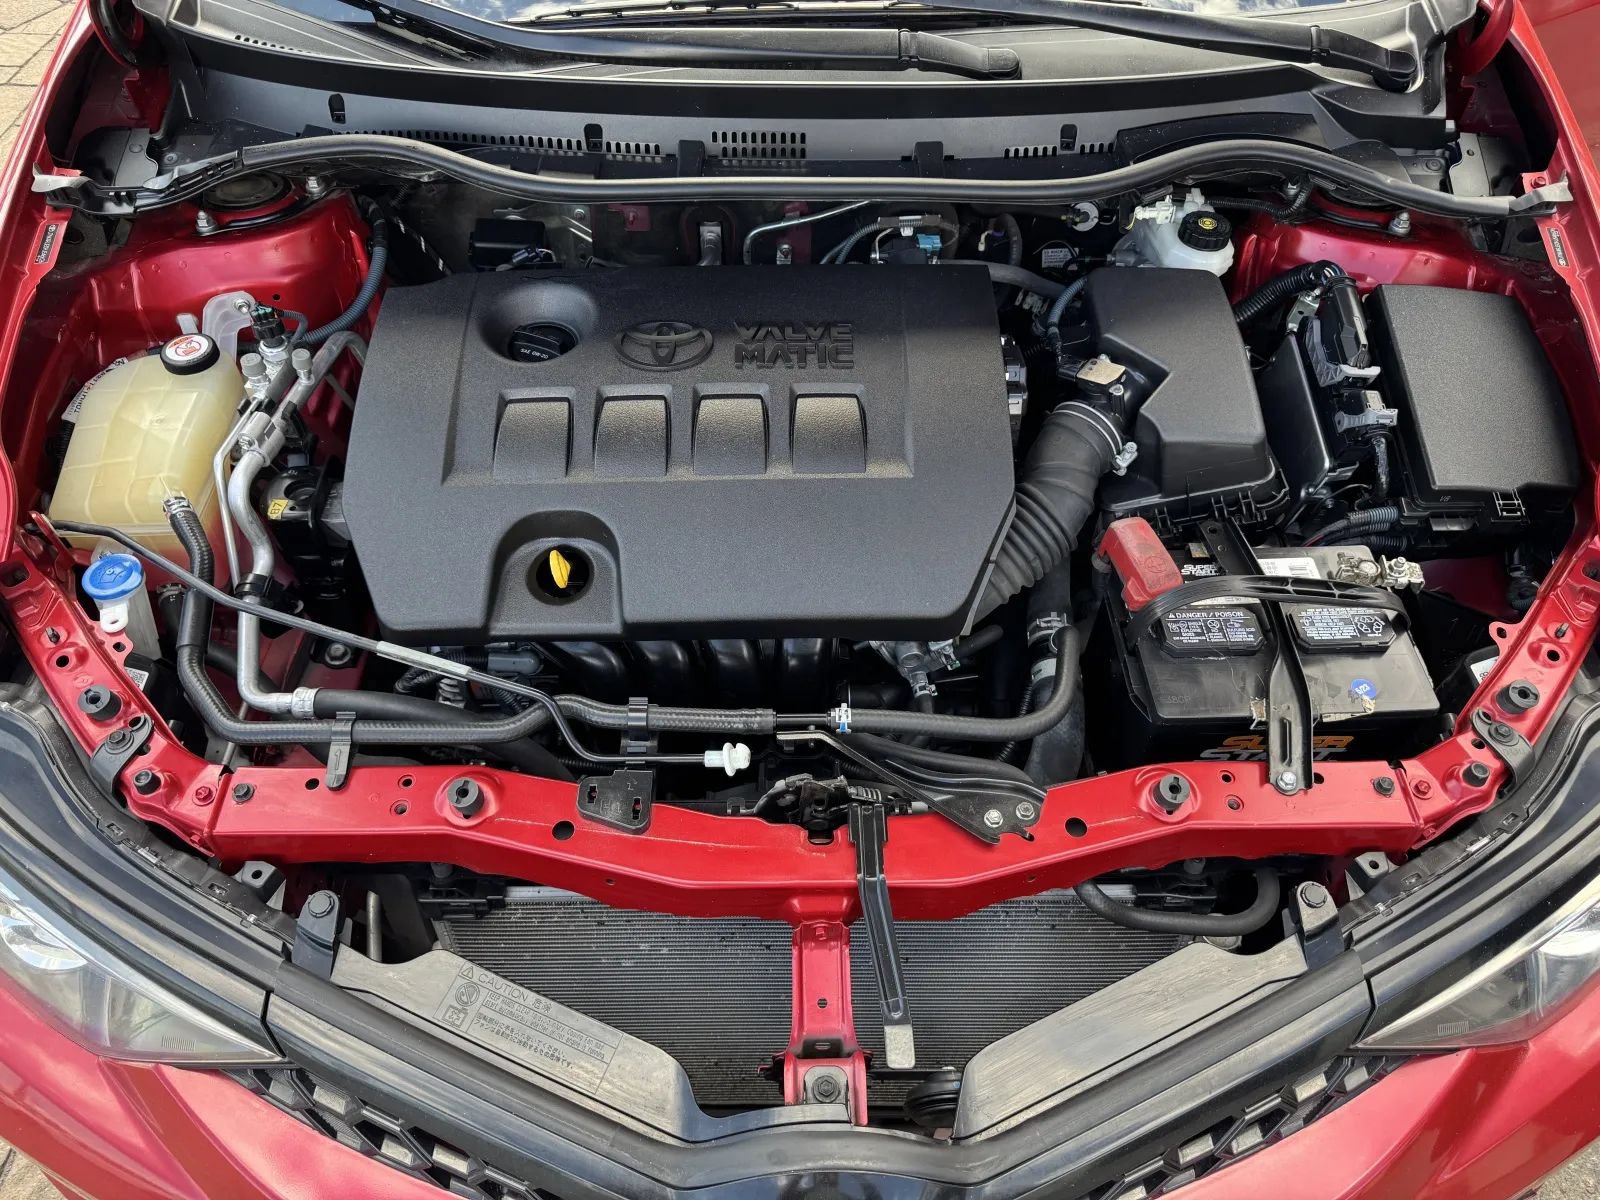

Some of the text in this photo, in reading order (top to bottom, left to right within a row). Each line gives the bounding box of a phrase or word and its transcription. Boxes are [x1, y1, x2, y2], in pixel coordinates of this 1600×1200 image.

[734, 321, 853, 341] VALVE
[735, 342, 854, 369] MATIC
[1221, 734, 1354, 750] SUER
[478, 973, 529, 1002] CAUTION
